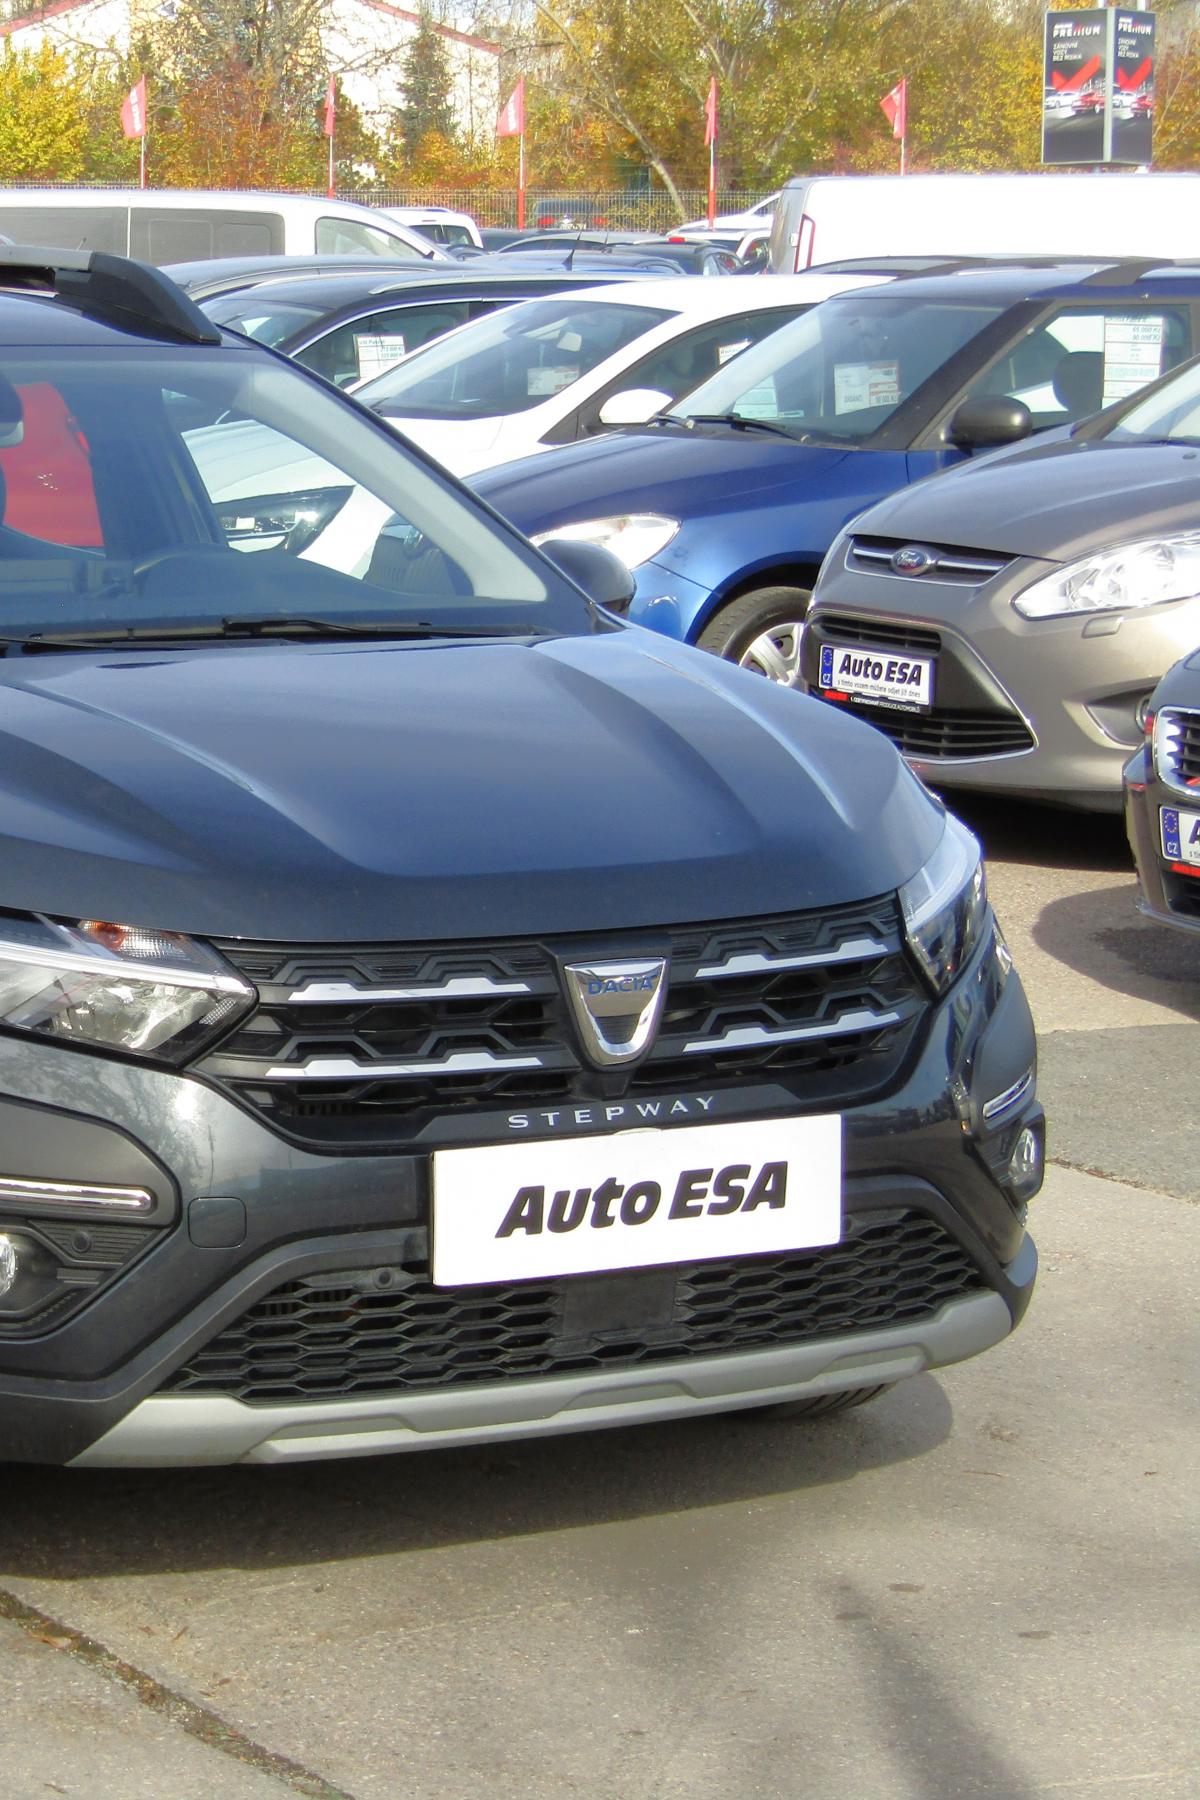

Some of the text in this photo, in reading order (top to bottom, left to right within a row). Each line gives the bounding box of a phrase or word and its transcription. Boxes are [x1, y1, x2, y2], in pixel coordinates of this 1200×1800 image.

[822, 673, 831, 683] CZ
[838, 654, 922, 687] Auto ESA
[1167, 841, 1179, 855] CZ
[587, 975, 654, 995] DACIA
[508, 1096, 714, 1129] STEPWAY
[494, 1161, 789, 1239] Auto ESA
